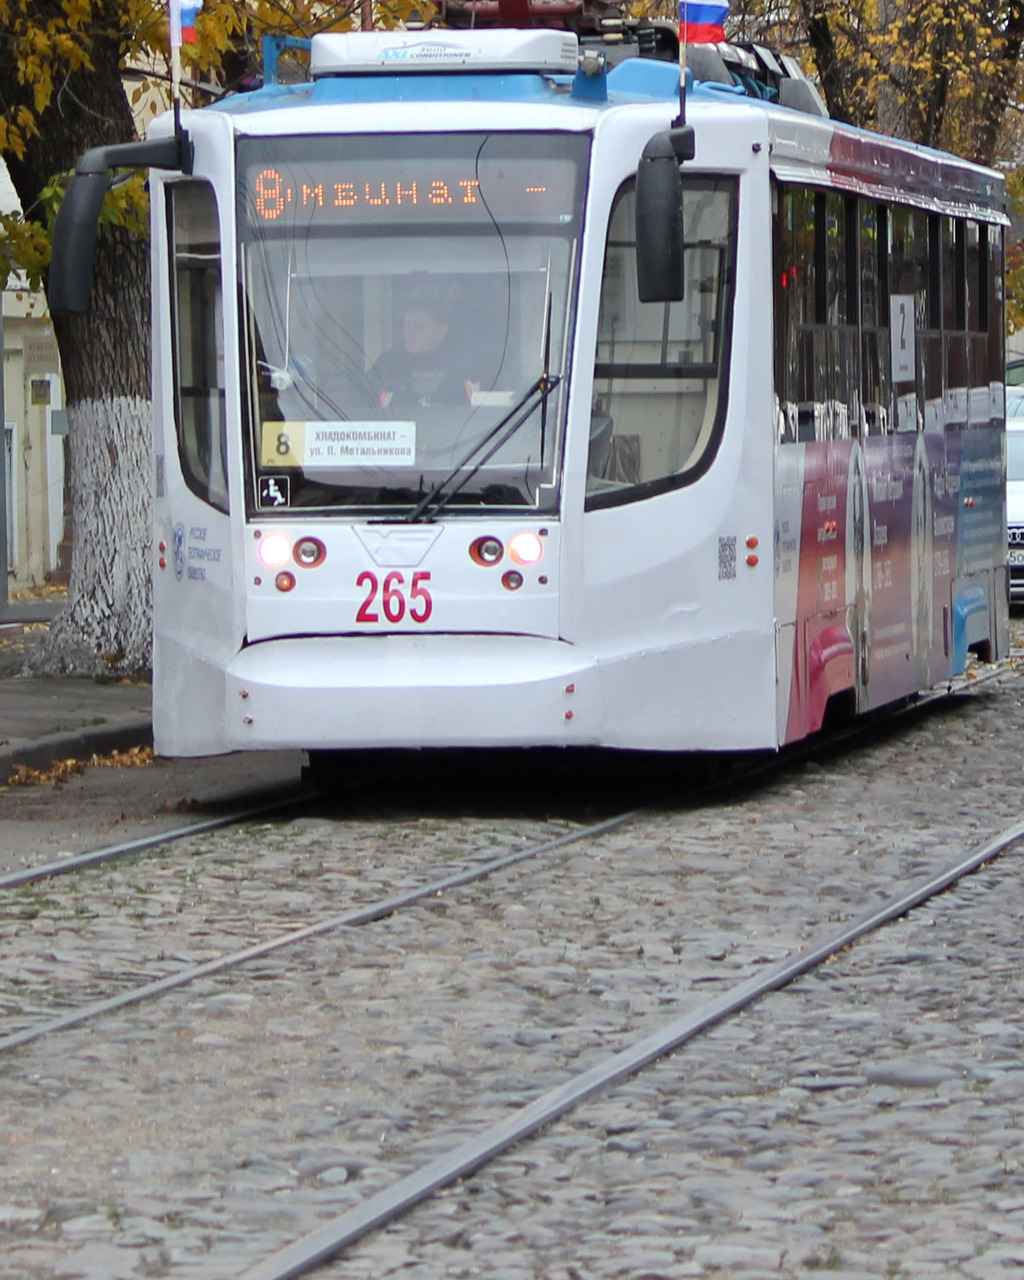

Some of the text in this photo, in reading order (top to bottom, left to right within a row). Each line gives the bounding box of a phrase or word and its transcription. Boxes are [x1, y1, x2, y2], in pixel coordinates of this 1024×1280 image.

[256, 169, 284, 219] 8
[276, 432, 291, 456] 8
[315, 431, 397, 443] ХЛАДОКОМБИНАТ
[309, 445, 412, 457] ул. П. Метальникова
[355, 570, 433, 624] 265
